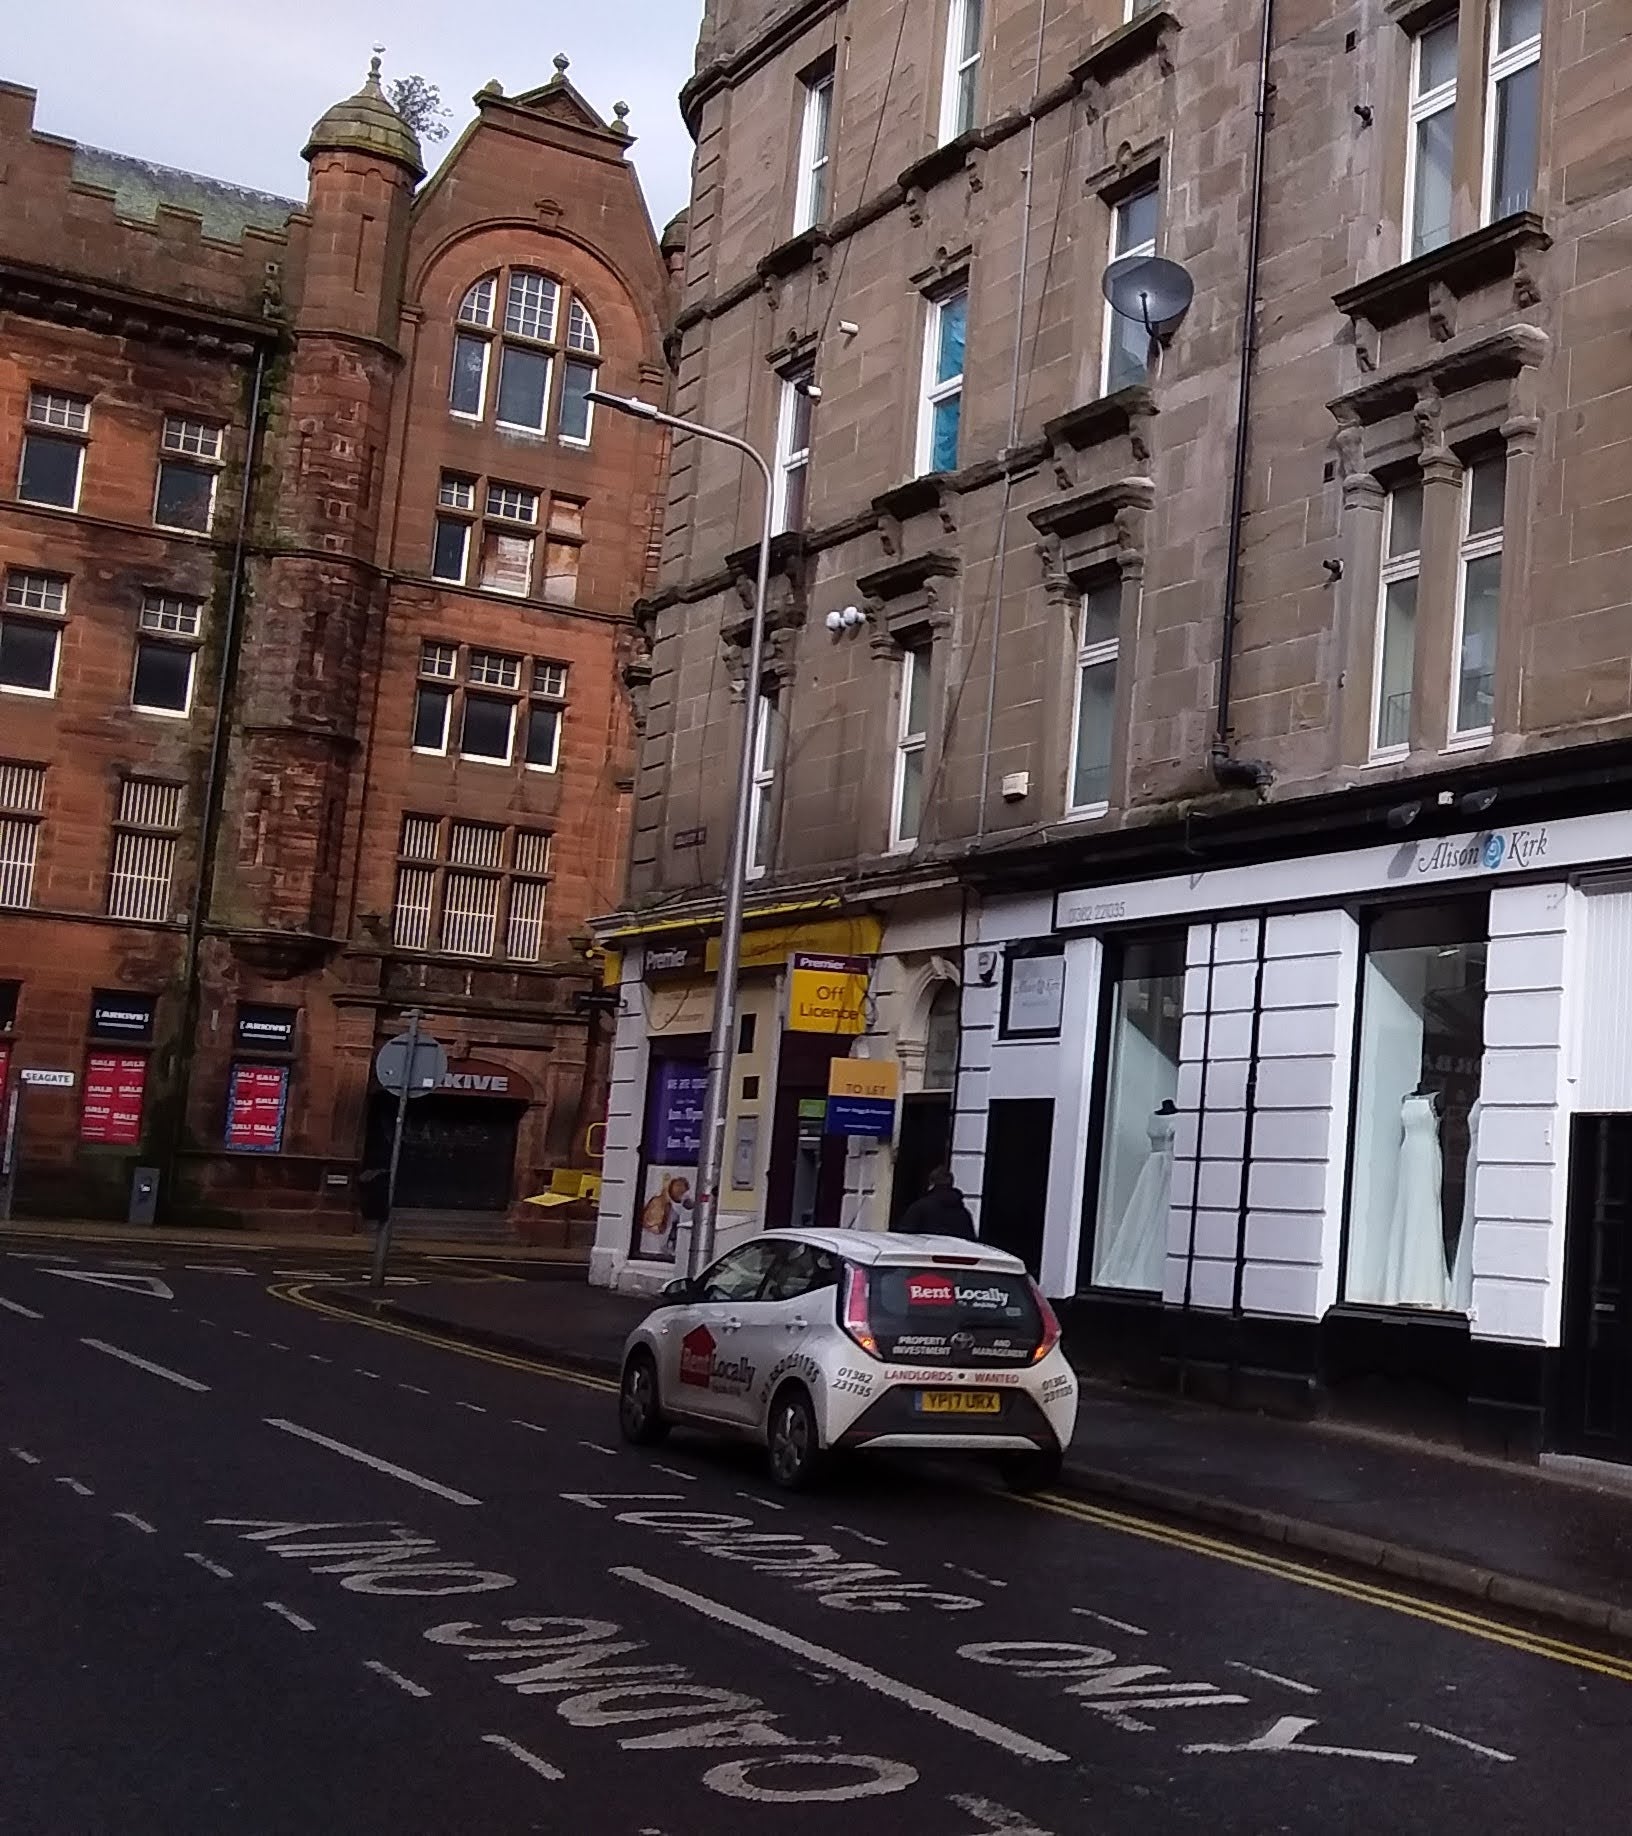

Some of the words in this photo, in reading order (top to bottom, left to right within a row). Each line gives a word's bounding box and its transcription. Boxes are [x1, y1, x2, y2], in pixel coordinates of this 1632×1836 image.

[1418, 842, 1479, 872] Alison
[1507, 828, 1548, 867] Kirk
[645, 948, 688, 971] Premier
[800, 957, 846, 970] Premier
[816, 985, 844, 1000] Off
[800, 1005, 859, 1020] Licence
[25, 1072, 71, 1083] SEAGATE
[439, 1073, 508, 1092] KIVE
[846, 1083, 863, 1094] TO
[867, 1085, 886, 1095] LET
[910, 1285, 951, 1299] Rent
[954, 1286, 1009, 1306] Locally
[899, 1336, 947, 1346] PROPERTY
[993, 1339, 1011, 1348] AND
[892, 1346, 951, 1356] INVESTMENT
[971, 1347, 1028, 1358] MANAGEMENT
[711, 1354, 755, 1391] Locally
[837, 1367, 873, 1383] 01382
[884, 1370, 953, 1382] LANDLORDS
[974, 1373, 1019, 1384] WANTED
[832, 1379, 873, 1397] 231135
[928, 1393, 962, 1409] YP17
[957, 1641, 1417, 1764] ONLY
